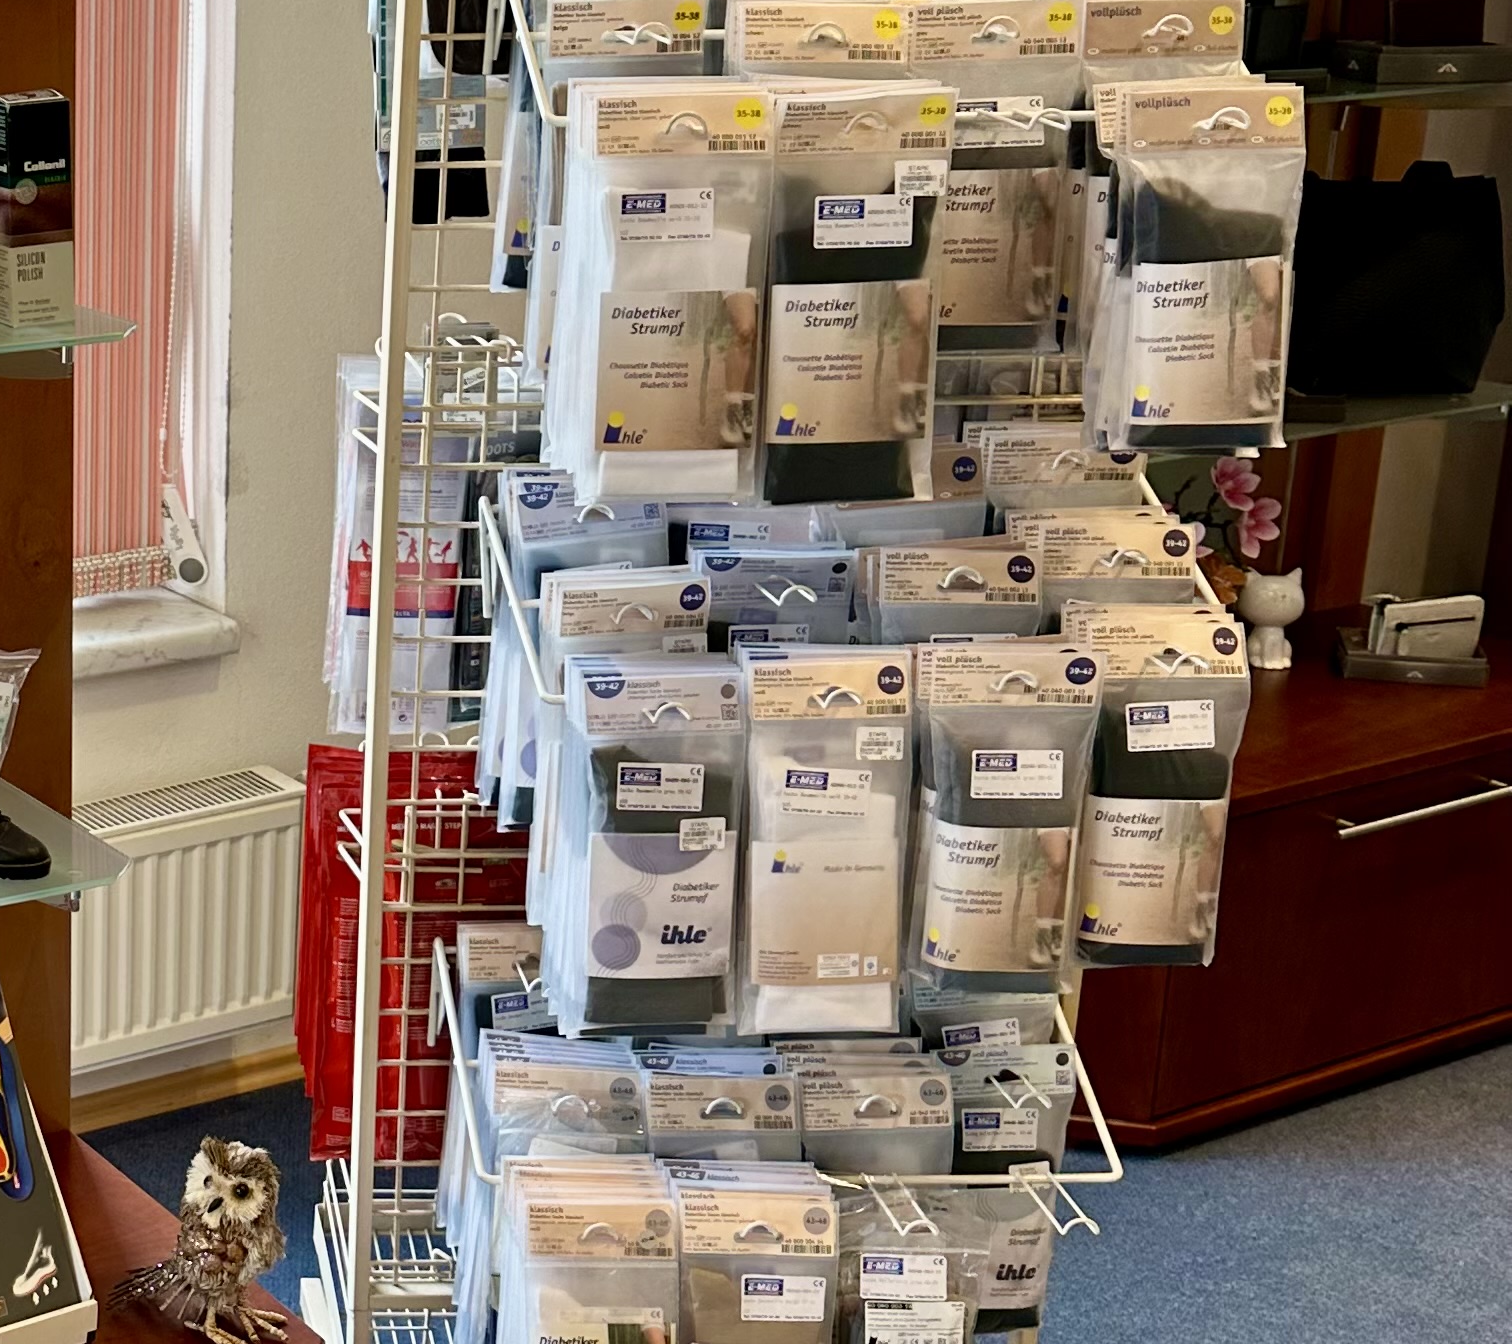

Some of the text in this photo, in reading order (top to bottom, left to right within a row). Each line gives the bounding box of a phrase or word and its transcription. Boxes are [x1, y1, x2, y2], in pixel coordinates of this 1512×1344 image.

[553, 2, 593, 12] klassisch
[745, 7, 783, 17] klassisch
[1090, 5, 1143, 20] vollplüsch
[674, 11, 701, 21] 35-38
[1048, 12, 1073, 23] 35-38
[1210, 15, 1234, 26] 35-38
[875, 21, 898, 30] 35-38
[598, 99, 638, 109] klassisch
[1135, 95, 1192, 111] vollplüsch
[736, 109, 762, 119] 35-38
[920, 106, 947, 116] 35-38
[1268, 107, 1292, 116] 35-38
[23, 158, 66, 172] Collonil
[625, 198, 662, 210] E-MED
[822, 205, 861, 216] E-MED
[16, 251, 46, 268] SILICON
[17, 266, 44, 284] POLISH
[1135, 278, 1205, 295] Diabetiker
[784, 298, 856, 313] Diabetiker
[1152, 292, 1210, 311] Strumpf
[611, 306, 682, 320] Diabetiker
[803, 314, 859, 331] Strumpf
[630, 321, 685, 338] Strumpf
[525, 493, 549, 504] 39-42
[1164, 538, 1188, 548] 39-42
[1009, 564, 1033, 574] 39-42
[682, 594, 704, 603] 39-42
[1213, 635, 1237, 645] 39-42
[1068, 665, 1095, 676] 39-42
[879, 675, 903, 685] 39-42
[594, 682, 620, 691] 39-42
[1131, 710, 1166, 721] E-MED
[979, 757, 1014, 769] E-MED
[1094, 809, 1162, 826] Diabetiker
[1111, 825, 1164, 843] Strumpf
[935, 833, 999, 853] Diabetiker
[947, 852, 1001, 869] Strumpf
[672, 882, 720, 892] Diabetiker
[669, 893, 709, 904] Strumpf
[660, 924, 708, 945] ihle
[805, 1216, 828, 1226] 43-46
[865, 1260, 901, 1272] E-MED
[996, 1263, 1038, 1282] ihle
[747, 1281, 780, 1292] E-MED
